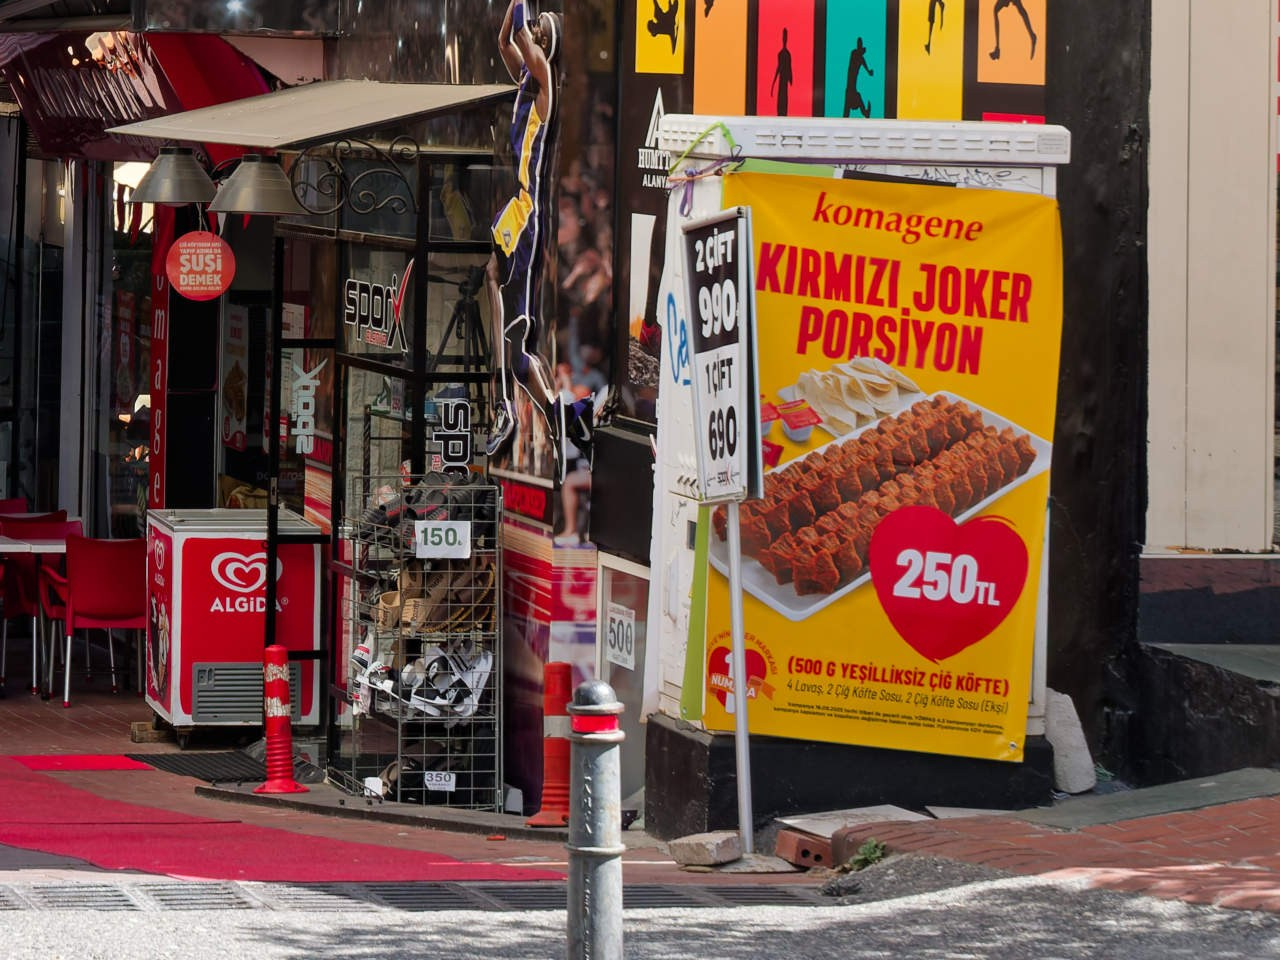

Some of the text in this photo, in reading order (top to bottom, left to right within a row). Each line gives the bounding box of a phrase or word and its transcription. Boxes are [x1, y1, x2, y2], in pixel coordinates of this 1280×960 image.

[812, 191, 984, 244] komagene
[695, 227, 735, 275] 2 ÇİFT
[180, 274, 222, 286] DEMEK
[755, 242, 1033, 323] KIRMIZI JOKER
[796, 304, 985, 376] PORSİYON
[705, 355, 734, 398] 1 ÇİFT
[708, 405, 738, 461] 690
[892, 548, 1001, 607] 250TL
[787, 679, 793, 690] 4
[827, 683, 834, 695] 2
[852, 686, 878, 700] Köfte
[906, 692, 913, 704] 2
[930, 694, 955, 709] Köfte
[956, 697, 980, 710] Sosu
[788, 656, 1010, 698] (500 G YEŞİLLİKSİZ ÇİĞ KÖFTE)
